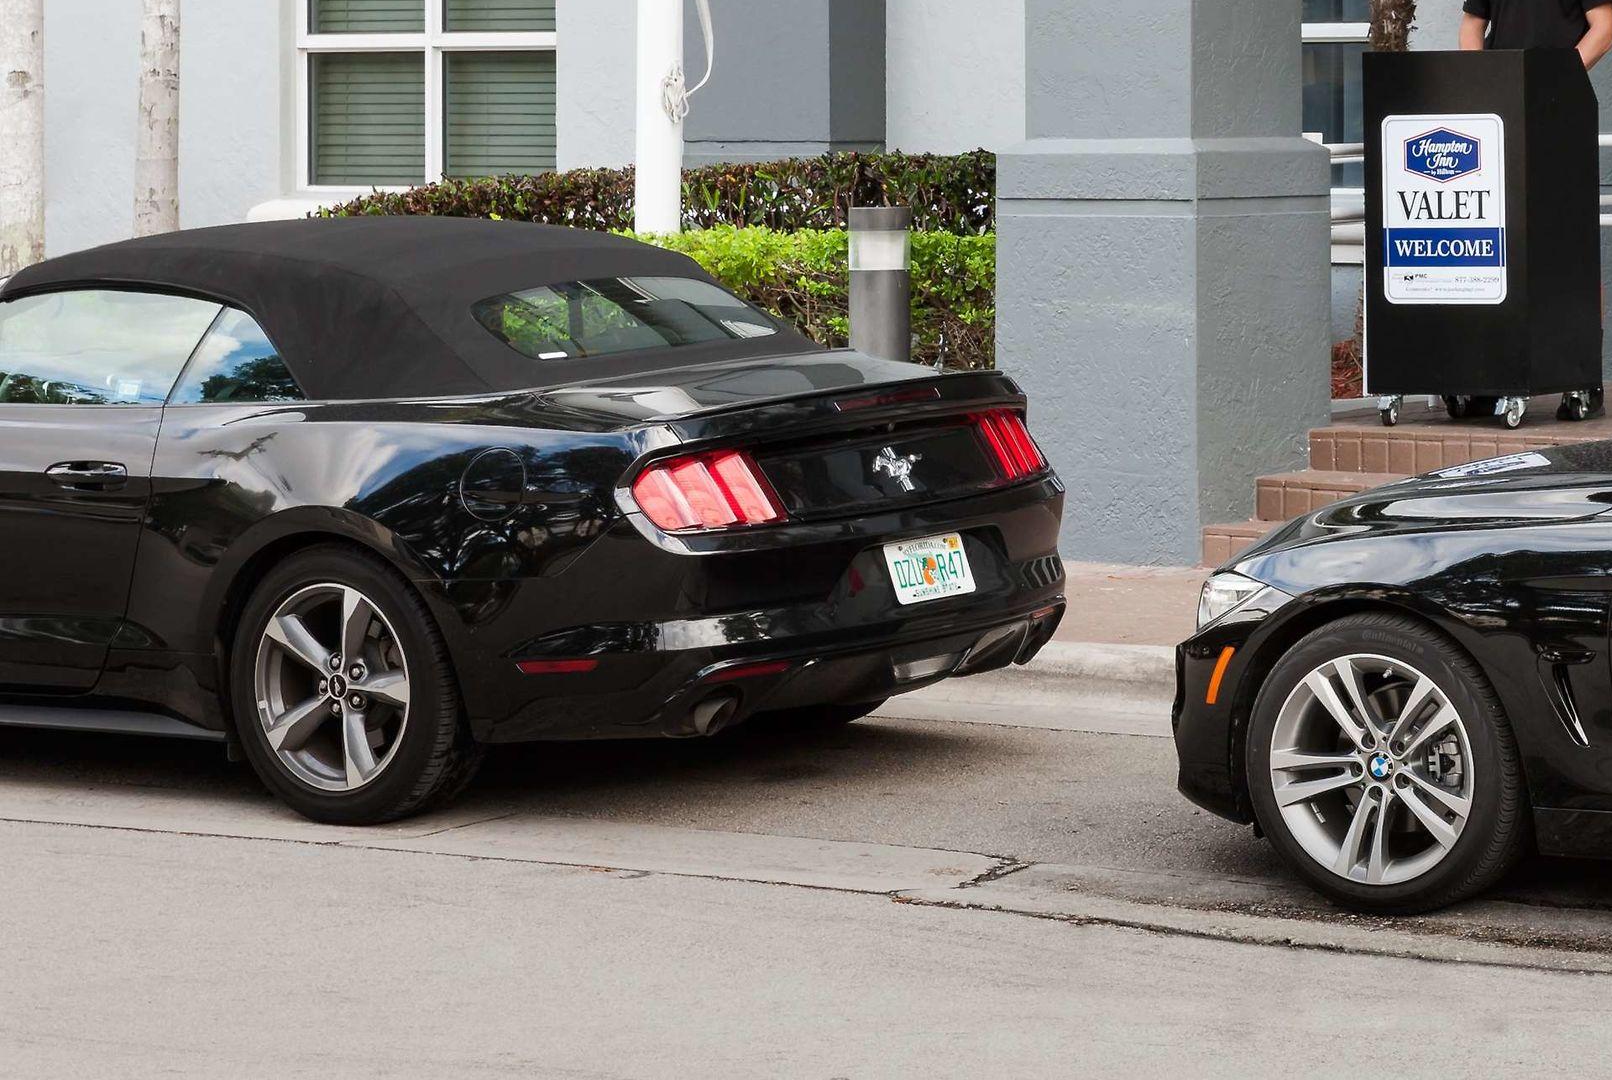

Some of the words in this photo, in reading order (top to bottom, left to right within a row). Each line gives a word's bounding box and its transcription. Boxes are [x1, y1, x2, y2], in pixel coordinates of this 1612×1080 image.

[1412, 138, 1473, 158] Hampton
[1426, 152, 1459, 169] Inn
[1397, 190, 1490, 220] VALET
[1395, 239, 1494, 257] WELCOME
